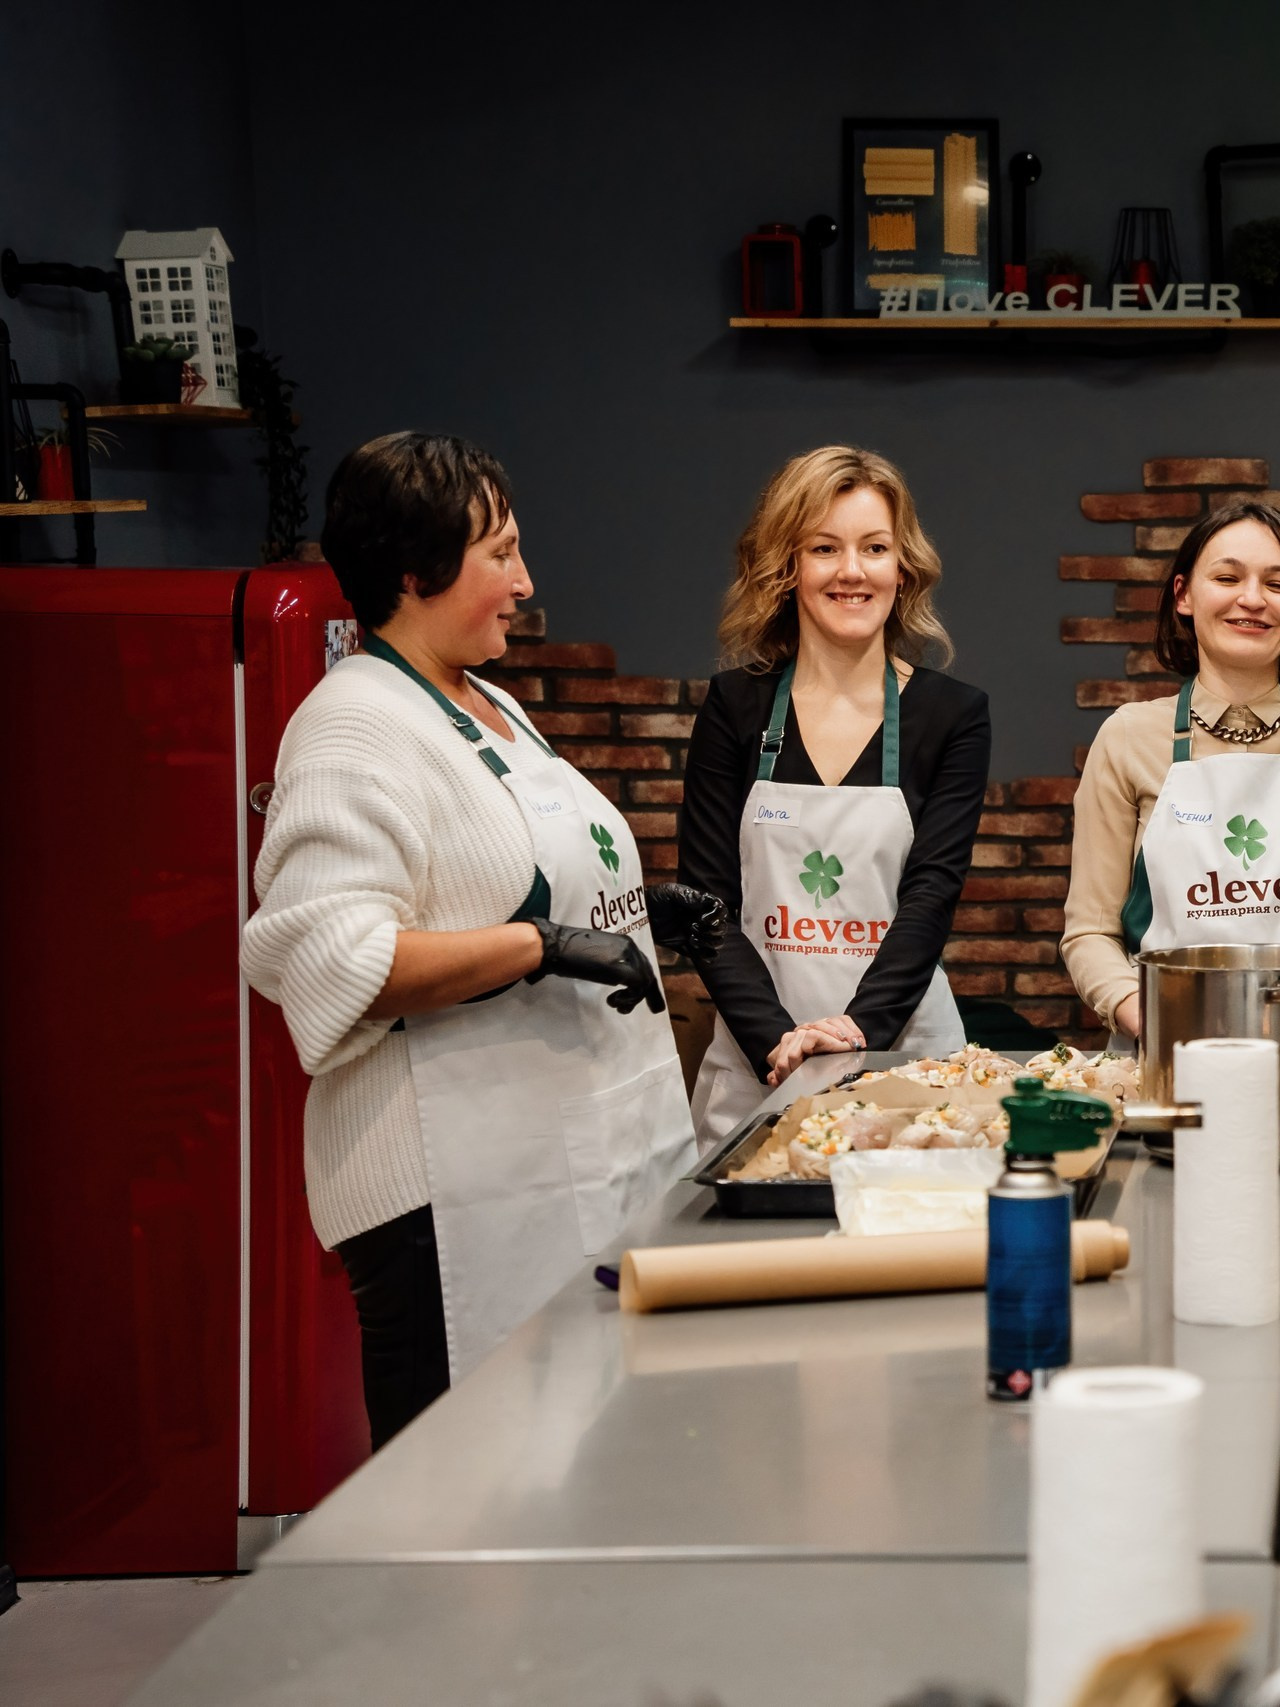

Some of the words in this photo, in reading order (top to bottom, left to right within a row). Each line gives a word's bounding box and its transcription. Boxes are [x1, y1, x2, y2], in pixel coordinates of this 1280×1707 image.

[935, 284, 1030, 312] love
[1046, 283, 1241, 312] CLEVER
[758, 805, 791, 819] Ольга
[590, 885, 646, 930] clever
[1186, 906, 1271, 919] кулинарная
[764, 905, 890, 944] clever
[764, 942, 838, 955] кулинарная
[842, 947, 878, 958] студ
